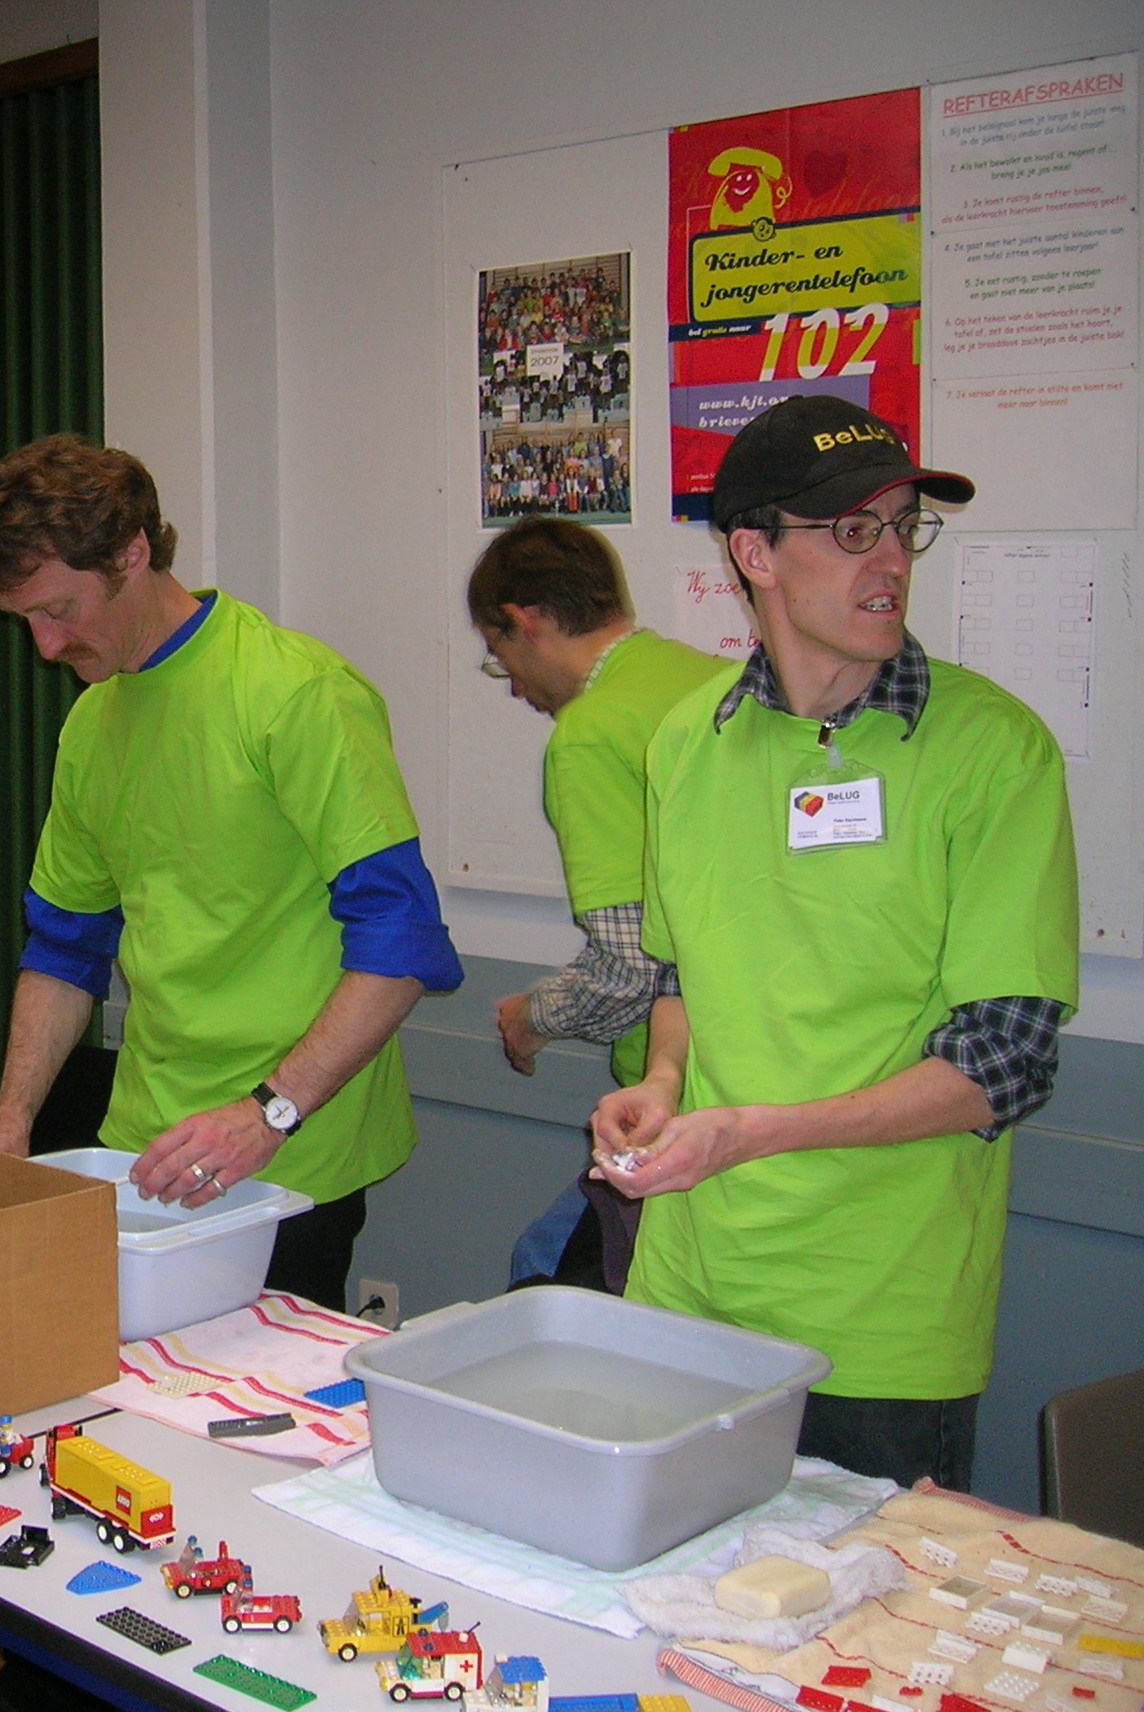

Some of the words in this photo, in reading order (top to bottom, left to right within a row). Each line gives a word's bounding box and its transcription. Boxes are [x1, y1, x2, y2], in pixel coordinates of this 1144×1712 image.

[943, 73, 1124, 114] REFTERAFSPRAKEN
[1071, 110, 1080, 118] de
[969, 137, 979, 145] de
[1044, 126, 1054, 135] de
[960, 161, 972, 171] Als
[974, 160, 988, 169] het
[1068, 147, 1096, 159] regent
[1016, 169, 1025, 179] je
[1027, 168, 1035, 178] je
[1038, 166, 1051, 177] jas
[972, 198, 983, 208] Je
[1032, 192, 1042, 200] de
[1044, 189, 1071, 198] refter
[954, 214, 964, 223] de
[1046, 200, 1099, 212] toestemming
[953, 243, 964, 252] Je
[1002, 237, 1017, 245] het
[704, 248, 805, 272] Kinder-
[814, 243, 844, 260] en
[983, 251, 1003, 261] tafel
[1005, 249, 1029, 259] zitten
[975, 278, 985, 287] Je
[987, 277, 1000, 286] eet
[1032, 271, 1059, 281] zonder
[1072, 268, 1101, 278] roepen
[700, 266, 908, 308] jongerentelefoon
[969, 292, 980, 300] en
[981, 290, 999, 301] gaat
[1001, 288, 1017, 297] niet
[1018, 287, 1040, 295] meer
[1057, 283, 1066, 294] je
[954, 317, 966, 327] Op
[968, 316, 982, 325] het
[983, 315, 1007, 323] teken
[1008, 314, 1022, 322] van
[1023, 311, 1034, 320] de
[1035, 308, 1079, 319] leerkracht
[1102, 305, 1111, 316] je
[1113, 305, 1122, 316] je
[688, 326, 702, 337] bel
[702, 325, 728, 338] gratis
[728, 324, 752, 333] naar
[954, 329, 973, 338] tafel
[988, 328, 1002, 336] zet
[1004, 326, 1014, 335] de
[1016, 324, 1046, 334] stoelen
[1048, 322, 1068, 332] zoals
[1070, 321, 1085, 329] het
[759, 302, 890, 382] 102
[944, 343, 955, 354] leg
[957, 343, 966, 353] je
[967, 343, 976, 353] je
[1020, 337, 1056, 347] zachtjes
[1058, 335, 1066, 343] in
[1067, 334, 1078, 343] de
[1080, 332, 1105, 344] juiste
[530, 355, 559, 367] 2007
[955, 390, 966, 399] Je
[997, 387, 1007, 396] de
[1009, 386, 1036, 395] refter
[1072, 385, 1082, 393] en
[1083, 382, 1104, 391] komt
[1106, 381, 1123, 391] niet
[699, 395, 789, 411] www.kjt.or
[699, 415, 756, 429] brieve
[720, 637, 742, 649] om
[827, 790, 860, 802] BeLUG
